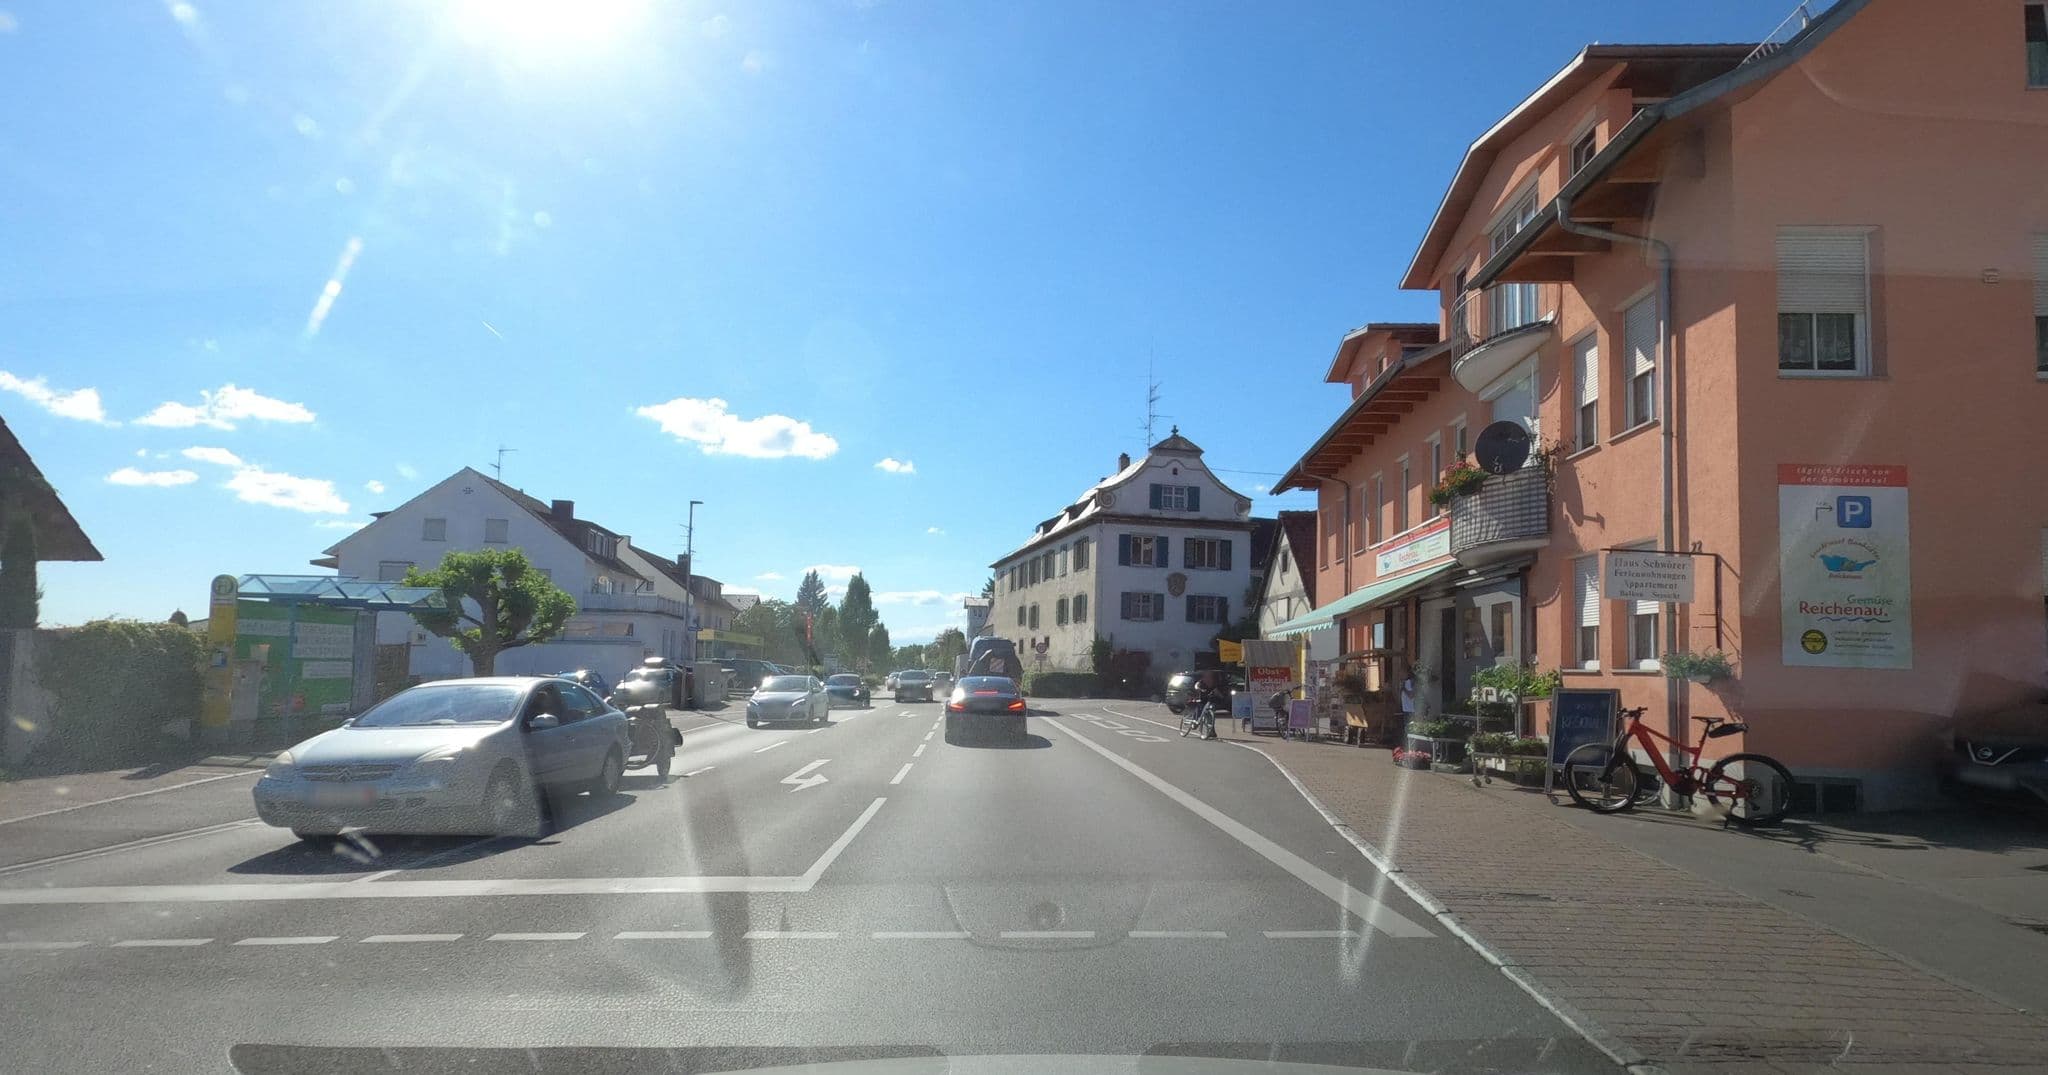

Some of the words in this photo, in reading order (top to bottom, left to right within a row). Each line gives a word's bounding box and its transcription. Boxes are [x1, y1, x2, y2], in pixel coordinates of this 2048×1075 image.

[1844, 501, 1864, 523] P
[1614, 569, 1687, 581] Ferienwohnungen
[1846, 593, 1894, 606] Gemüse
[1799, 600, 1889, 617] Reichenau.
[1068, 713, 1171, 743] BUS
